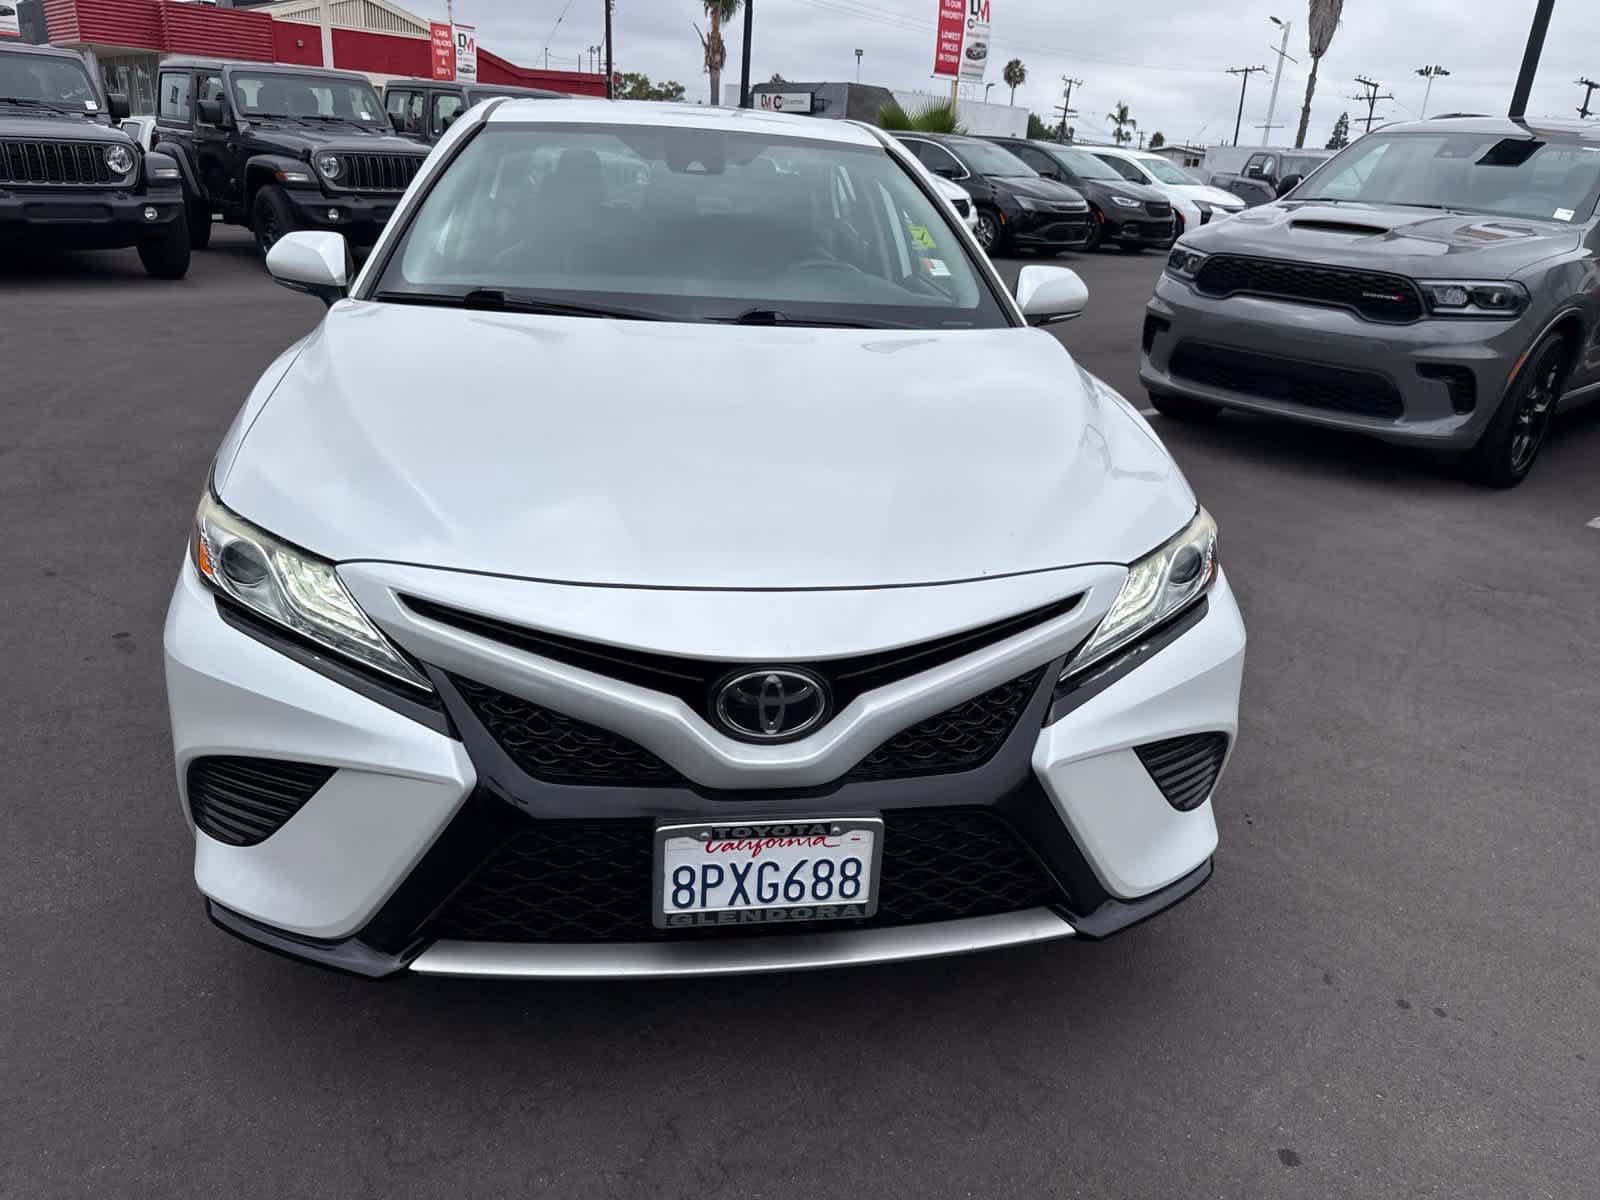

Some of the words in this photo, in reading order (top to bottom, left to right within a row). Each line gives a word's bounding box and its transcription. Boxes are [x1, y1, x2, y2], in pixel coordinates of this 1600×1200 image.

[941, 9, 964, 20] PRIORITY
[434, 29, 449, 38] CARS
[941, 29, 961, 40] LOWEST
[433, 38, 452, 48] TRUCKS
[458, 32, 474, 52] DM
[942, 41, 959, 52] PRICES
[713, 824, 828, 839] TOYOTA
[671, 857, 863, 909] 8PXG688
[669, 904, 862, 926] GLENDORA
